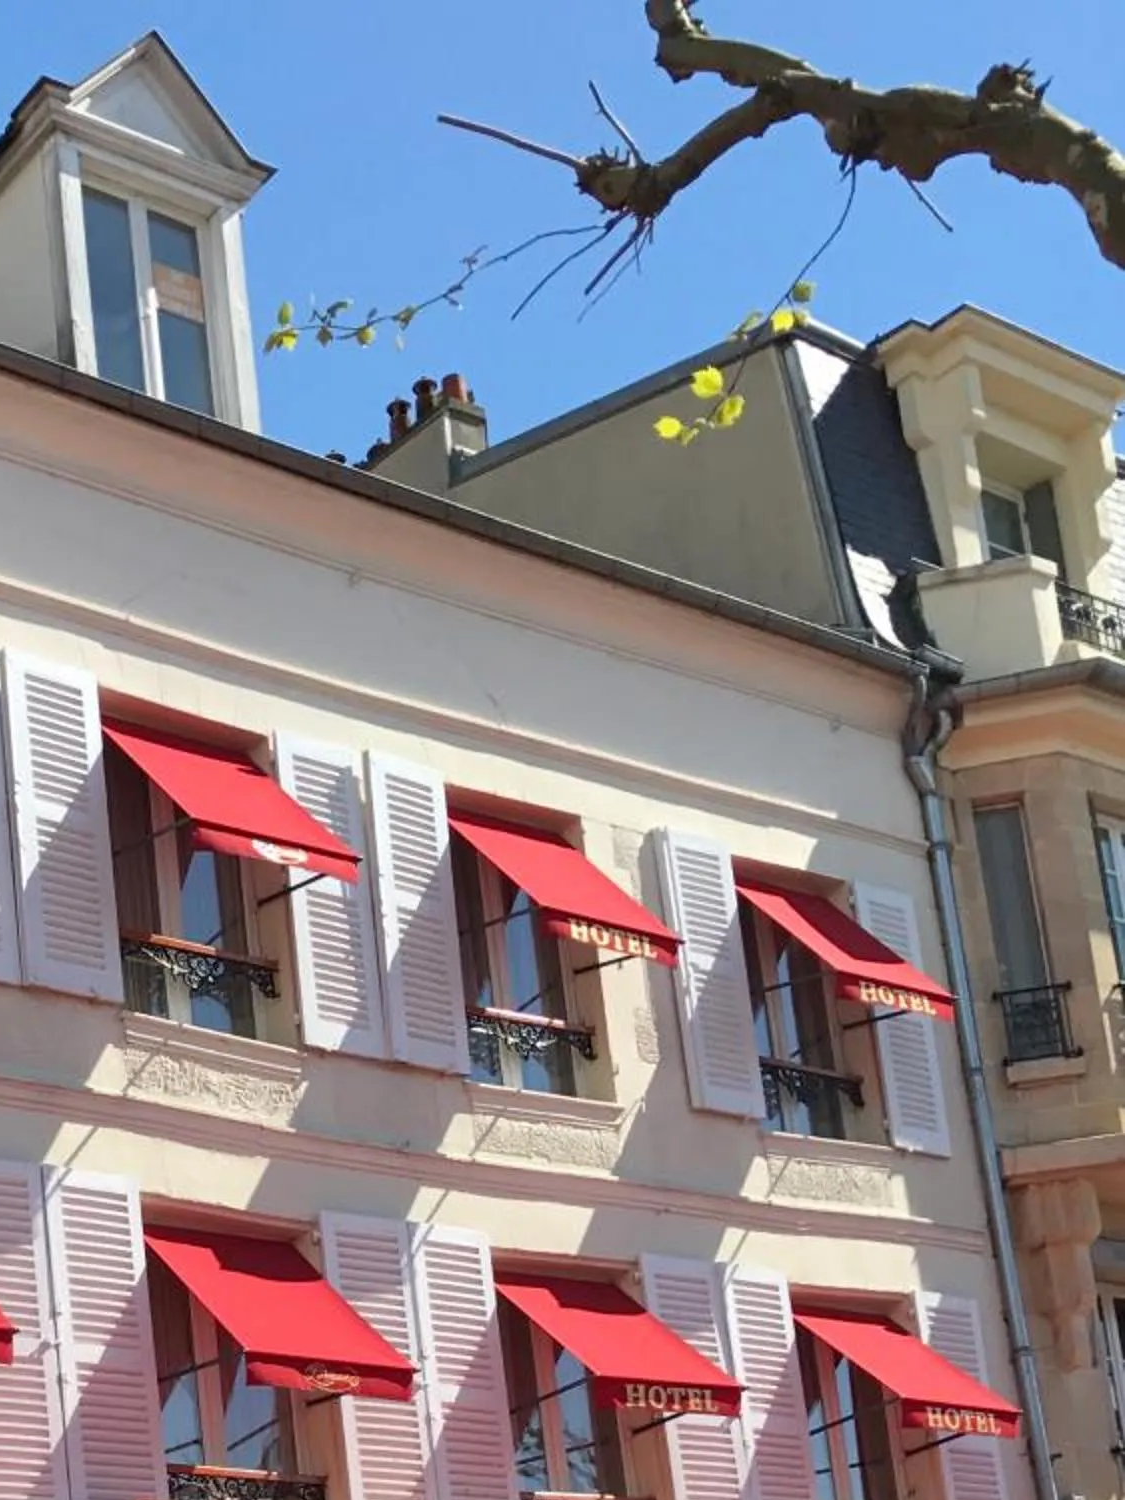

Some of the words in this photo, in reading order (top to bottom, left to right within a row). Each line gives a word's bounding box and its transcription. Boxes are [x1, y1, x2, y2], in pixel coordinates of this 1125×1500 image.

[567, 918, 658, 958] HOTEL
[859, 980, 938, 1015] HOTEL
[624, 1383, 719, 1412] HOTEL
[925, 1406, 1002, 1435] HOTEL
